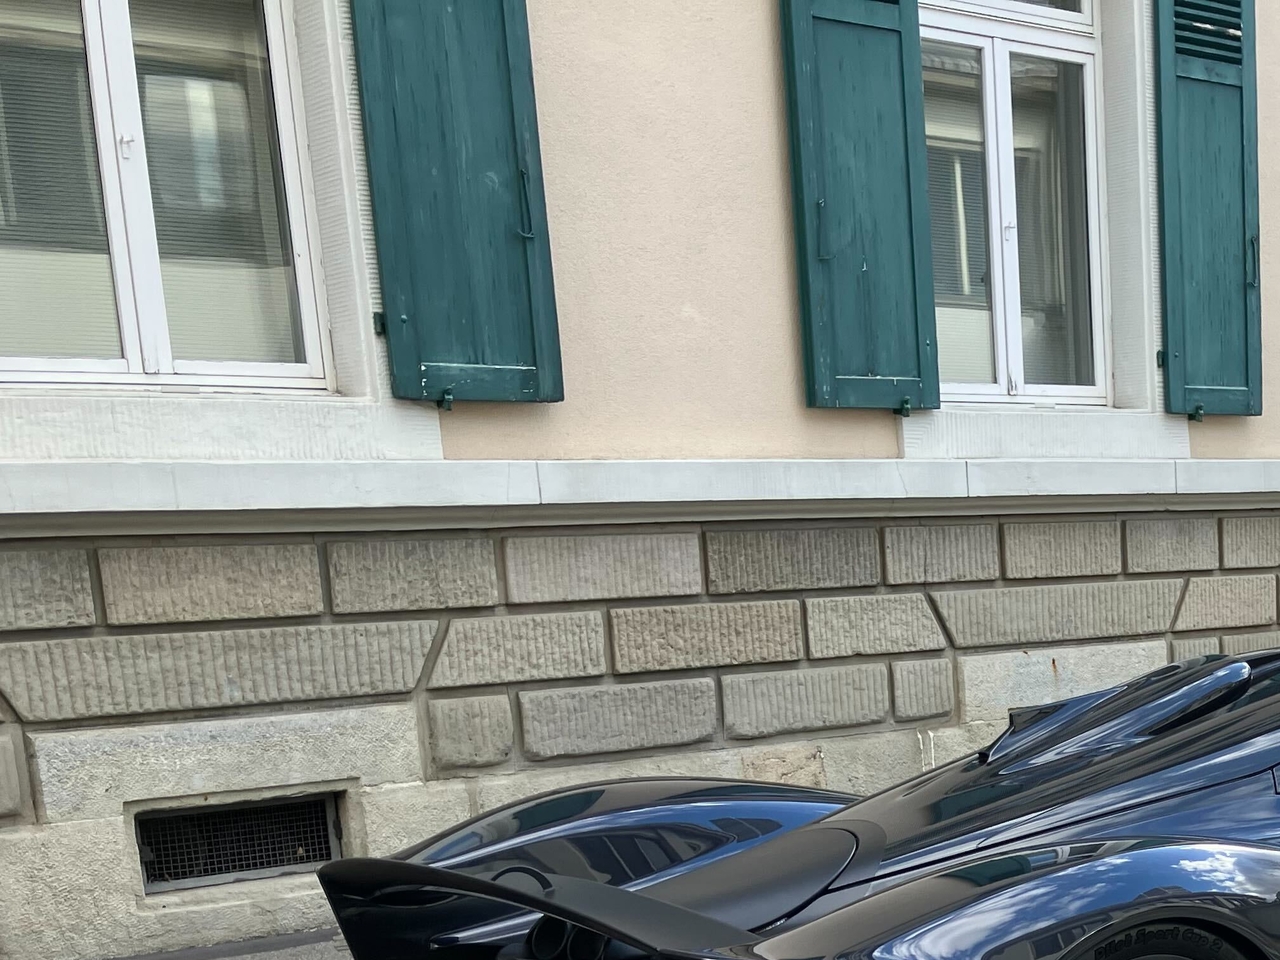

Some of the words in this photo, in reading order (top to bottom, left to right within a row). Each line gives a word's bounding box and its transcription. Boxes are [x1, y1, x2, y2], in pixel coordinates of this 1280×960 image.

[1134, 926, 1180, 945] Sport
[1182, 928, 1210, 947] Cup
[1210, 938, 1224, 953] 2
